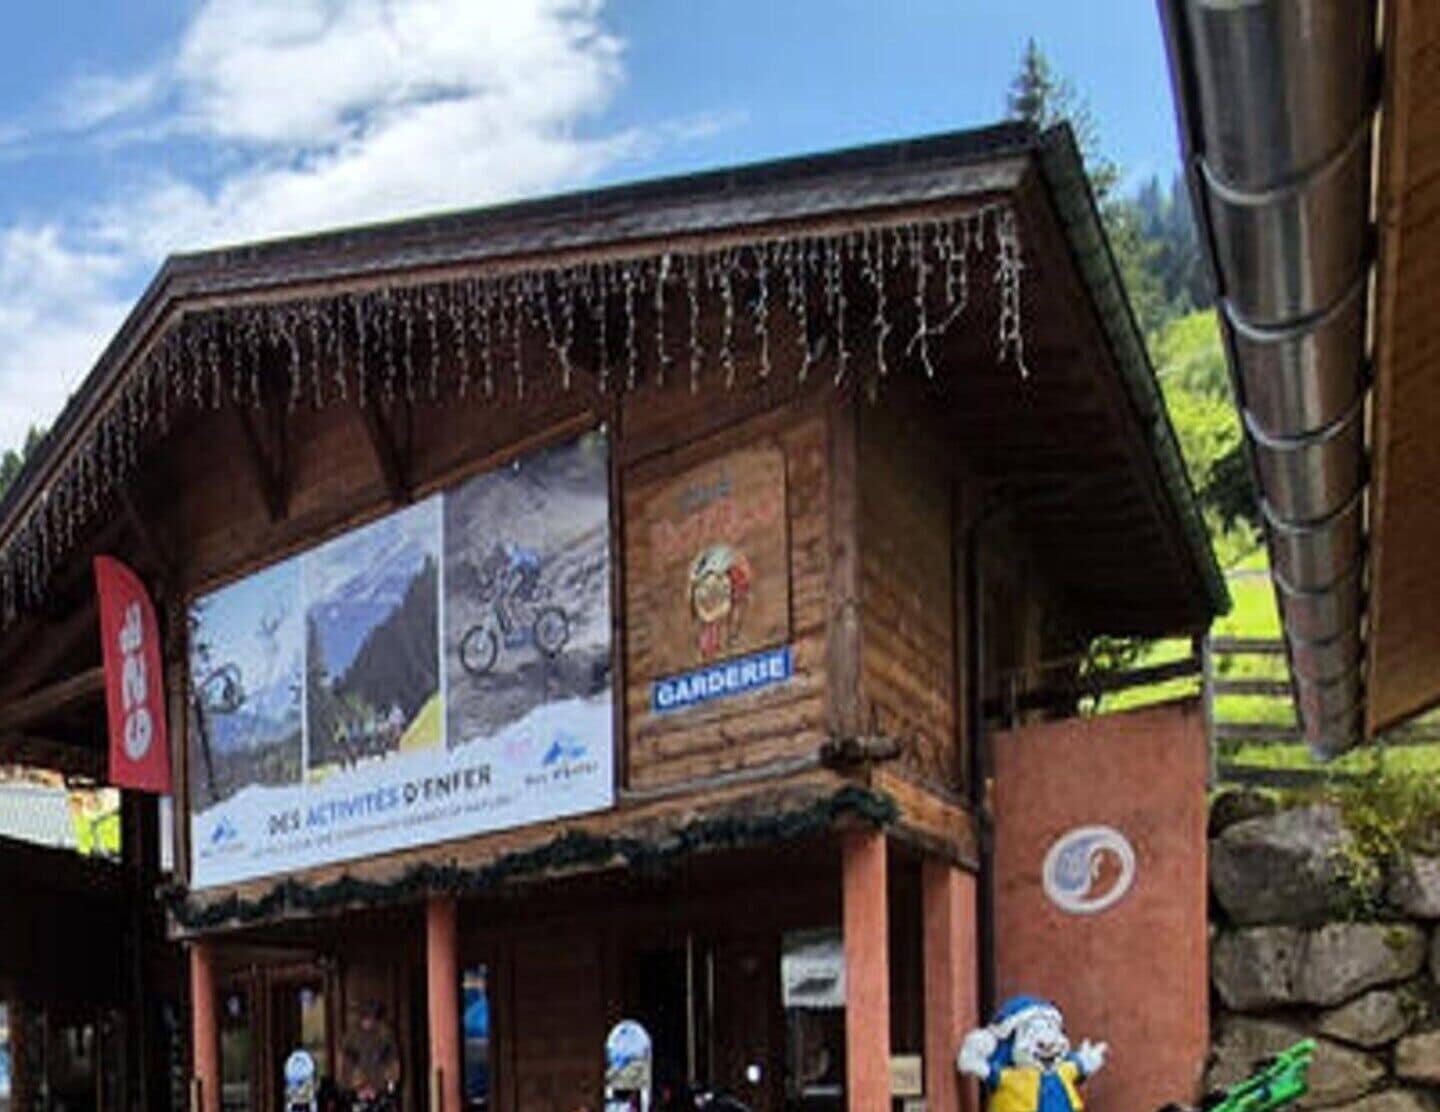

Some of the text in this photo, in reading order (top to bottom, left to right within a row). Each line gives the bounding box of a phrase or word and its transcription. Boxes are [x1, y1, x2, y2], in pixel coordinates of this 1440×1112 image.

[657, 655, 785, 706] GARDERIE
[269, 806, 300, 835] DES
[306, 785, 398, 827] ACTIVITÉS
[403, 765, 491, 803] D'ENFER
